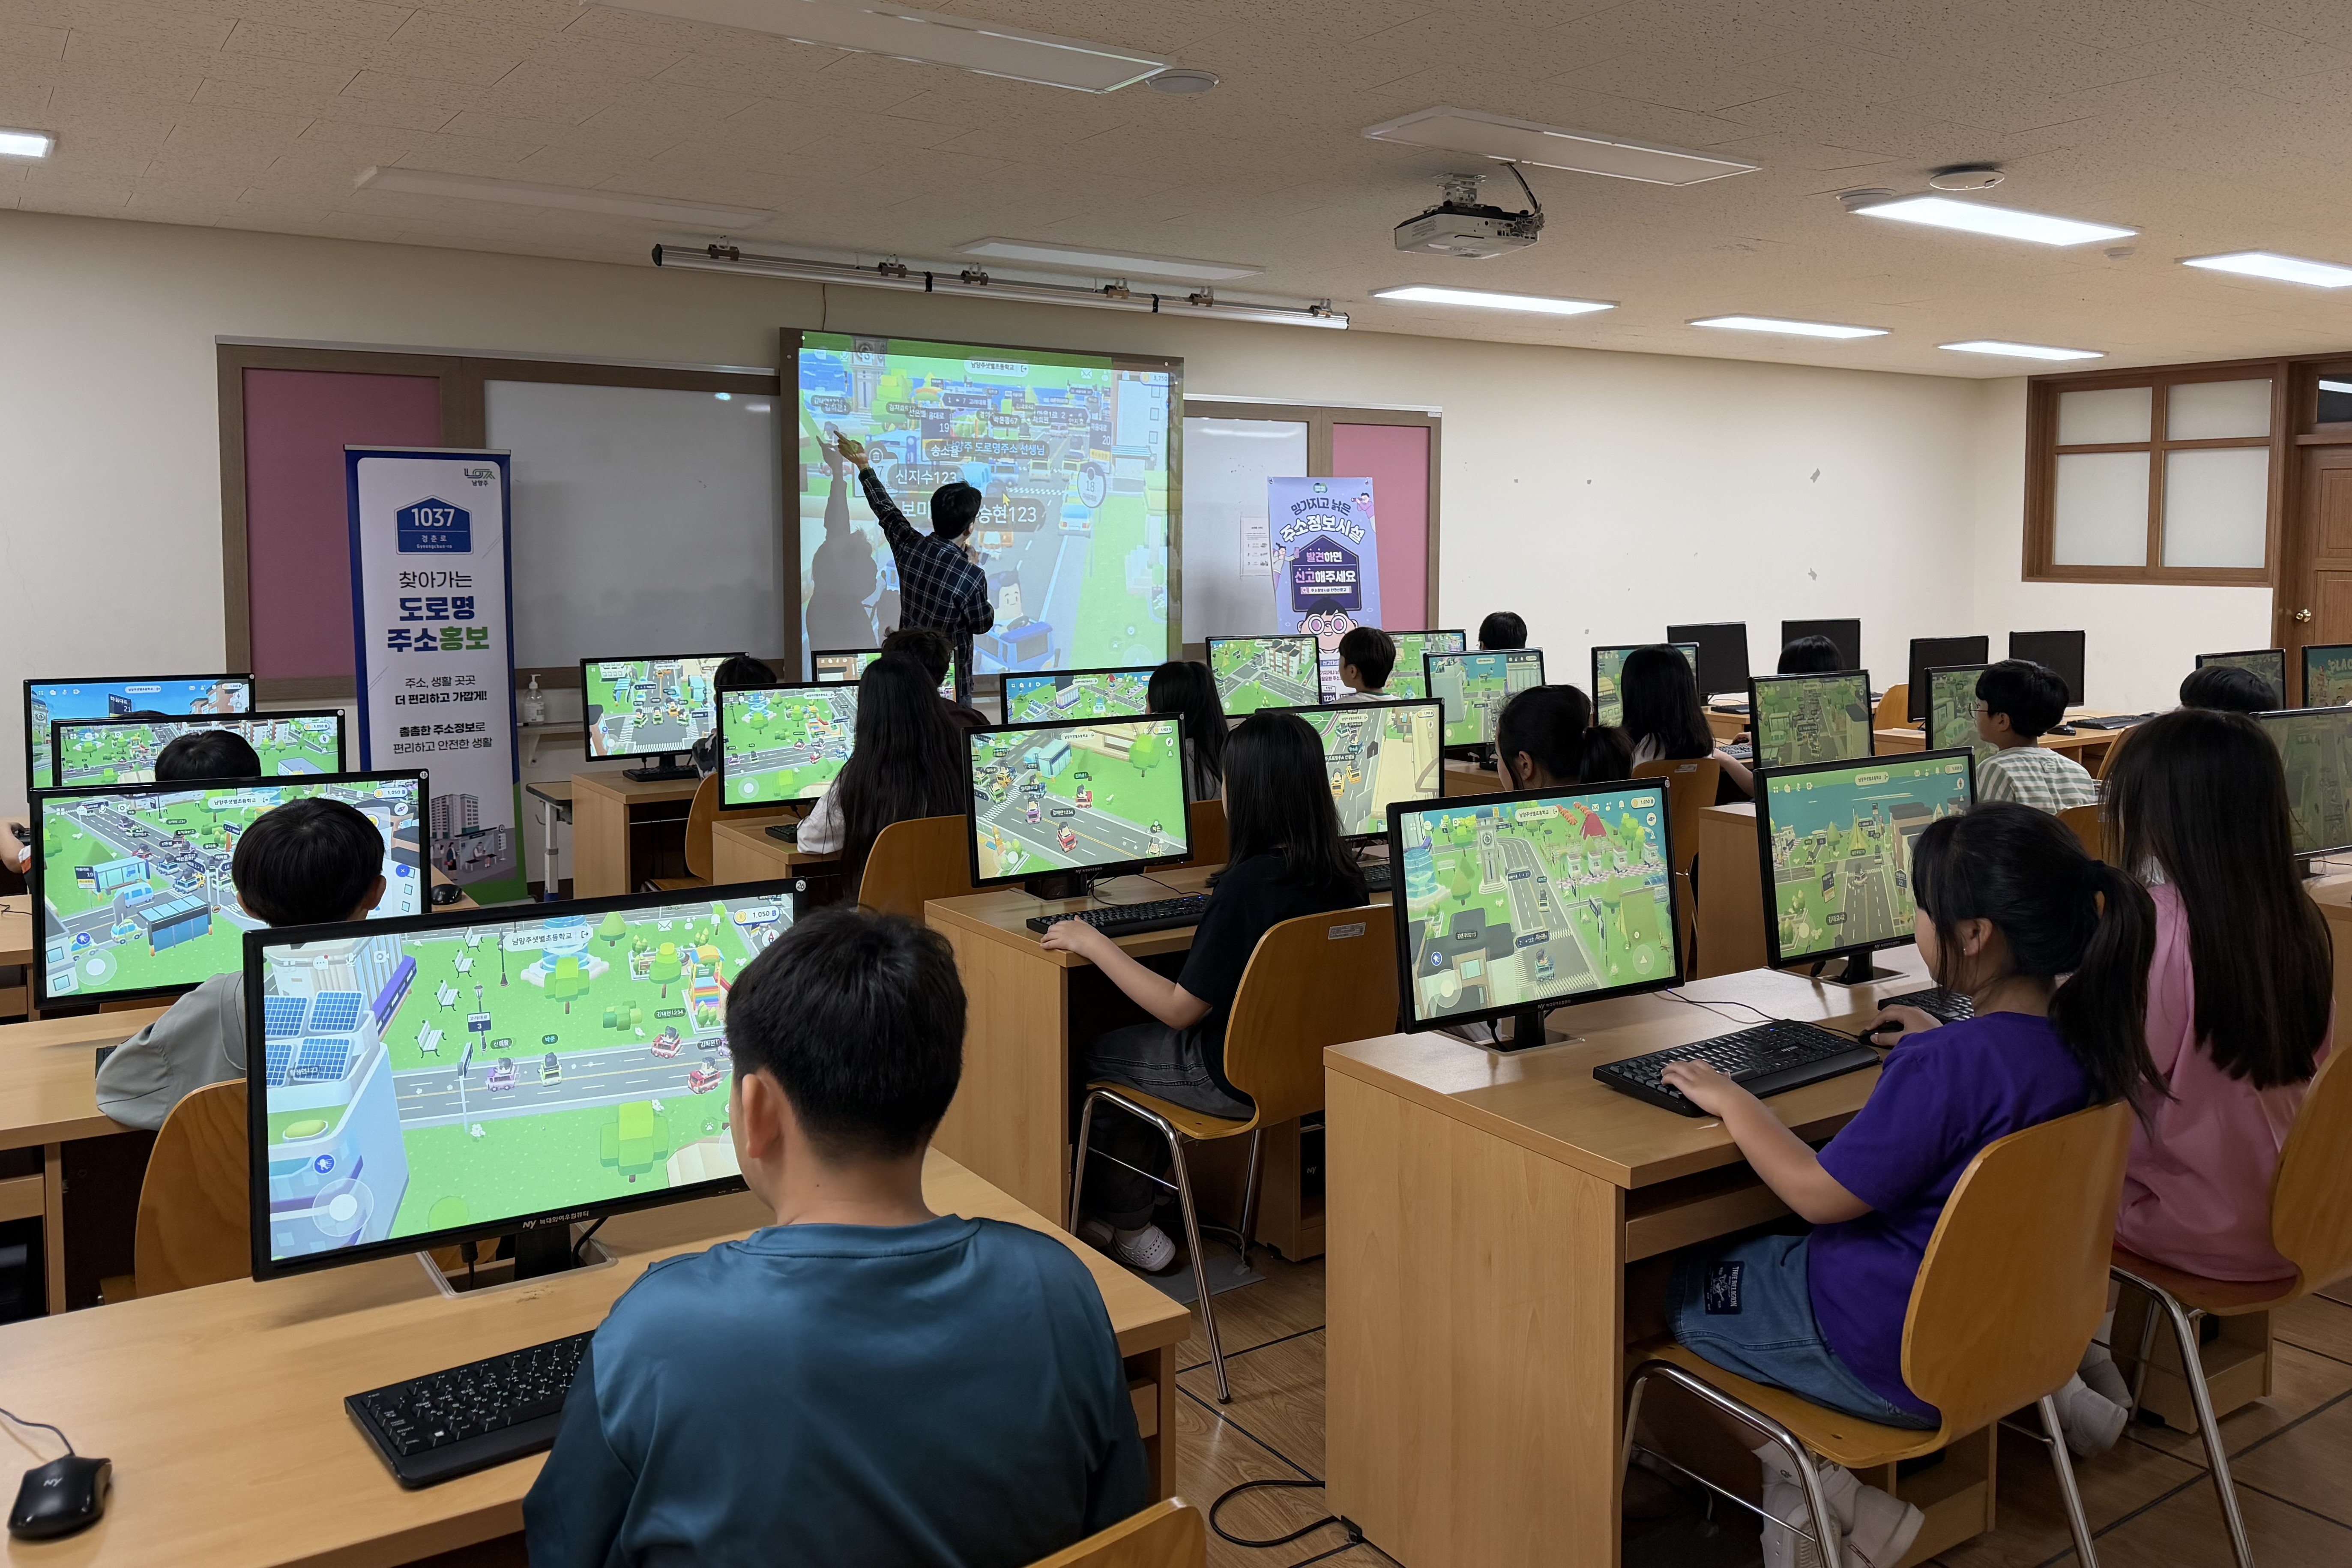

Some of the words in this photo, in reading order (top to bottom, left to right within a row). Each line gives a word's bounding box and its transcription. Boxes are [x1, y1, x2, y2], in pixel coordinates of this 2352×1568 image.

[940, 422, 949, 433] 19
[1102, 435, 1110, 445] 20
[975, 442, 1018, 454] 도로명주소
[1020, 444, 1045, 455] 선생님
[895, 470, 957, 485] 신지수123
[1086, 480, 1095, 492] 18
[1290, 497, 1329, 516] 망가지고
[1332, 499, 1351, 516] 낡은
[411, 507, 455, 527] 1037
[1279, 514, 1366, 545] 주소정보시설
[1306, 551, 1342, 563] 발견하면
[399, 571, 473, 589] 찾아가는
[1294, 570, 1356, 584] 신고해주세요
[399, 595, 475, 621] 도로명
[387, 626, 490, 652] 주소홍보
[405, 677, 429, 689] 주소,
[431, 676, 452, 688] 생활
[455, 675, 476, 686] 곳곳
[395, 694, 406, 705] 더
[408, 693, 450, 704] 편리하고
[453, 691, 488, 702] 가깝게!
[399, 726, 431, 737] 촘촘한
[433, 722, 485, 736] 주소정보로
[393, 741, 435, 754] 편리하고
[438, 739, 470, 751] 안전한
[472, 737, 493, 748] 생활
[512, 932, 572, 946] 남양주샛별초등학교
[522, 1220, 537, 1229] NY
